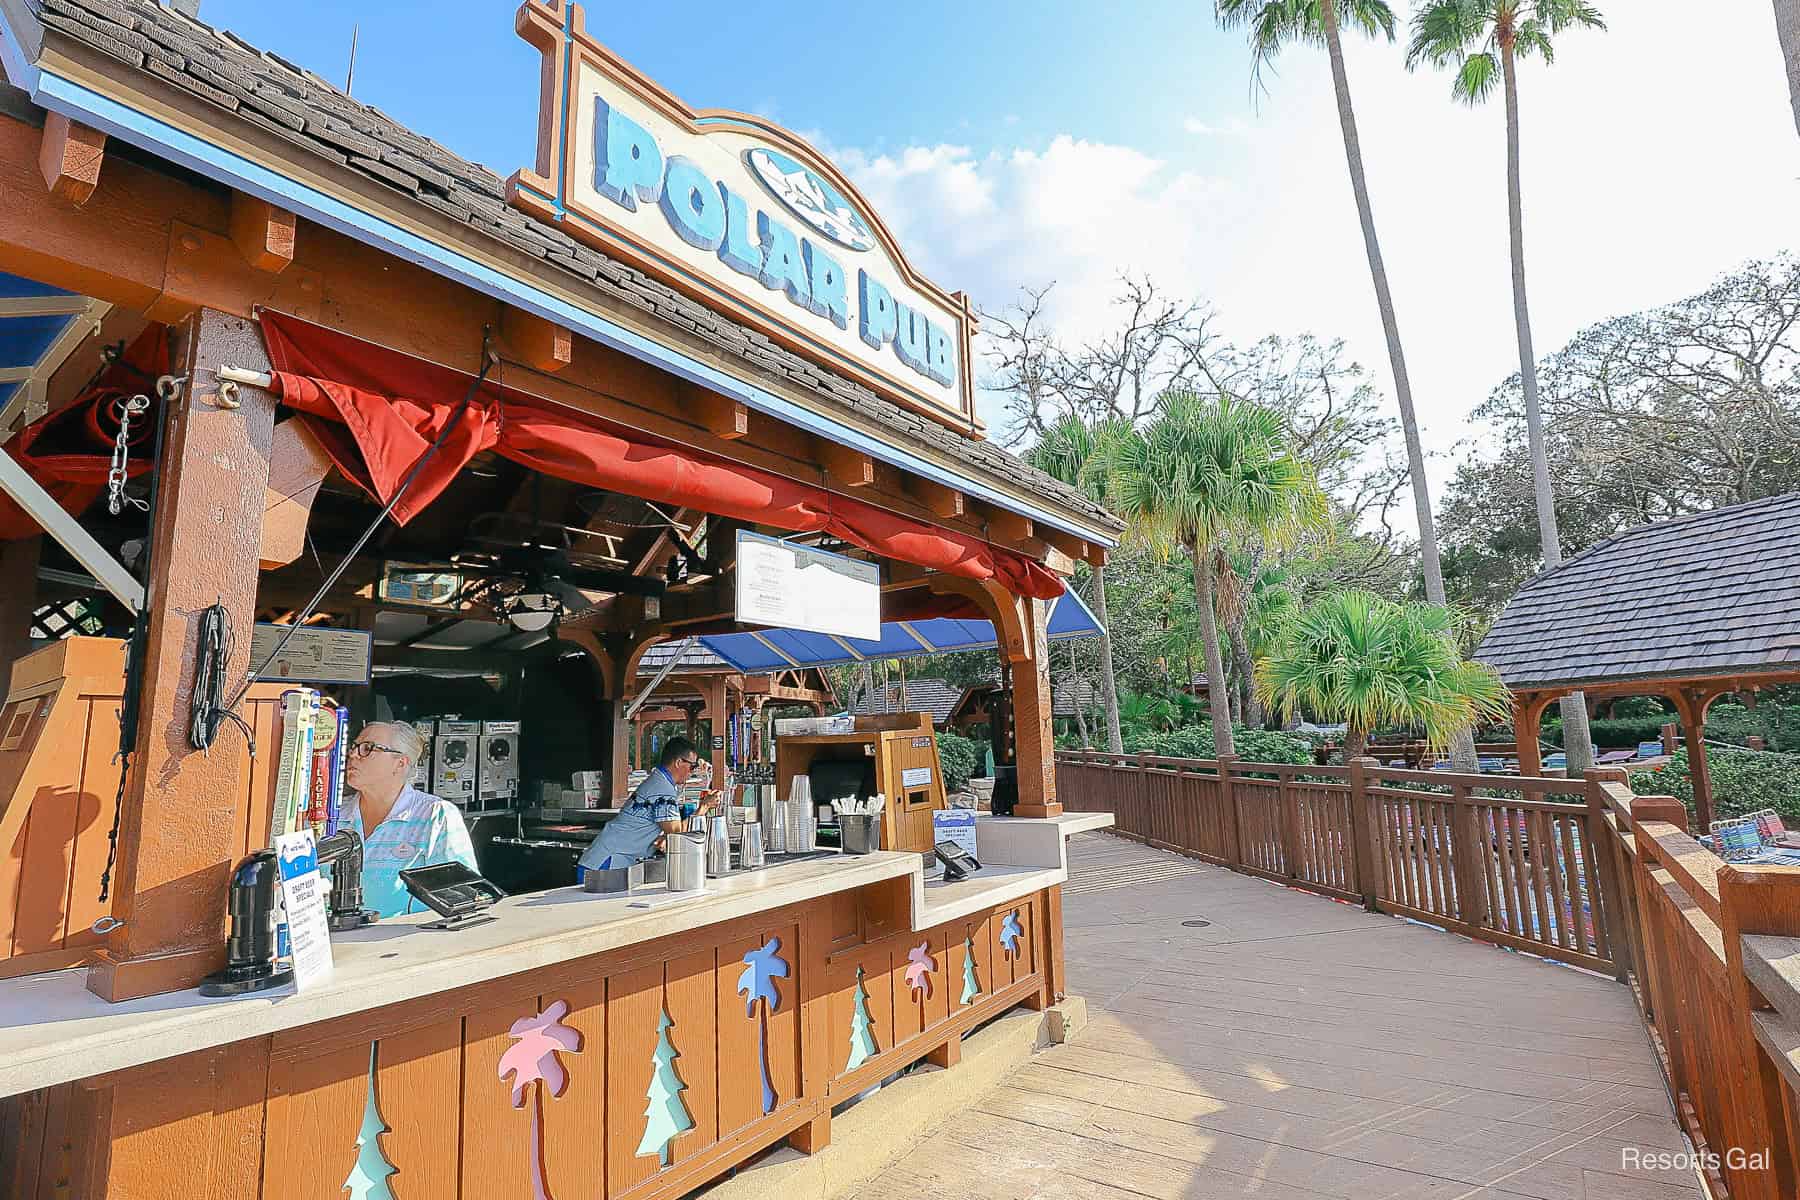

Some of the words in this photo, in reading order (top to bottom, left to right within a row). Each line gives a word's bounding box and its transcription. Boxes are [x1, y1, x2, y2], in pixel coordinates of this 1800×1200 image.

[593, 96, 847, 331] POLAR
[859, 267, 955, 389] PUB
[315, 768, 324, 808] LAGER
